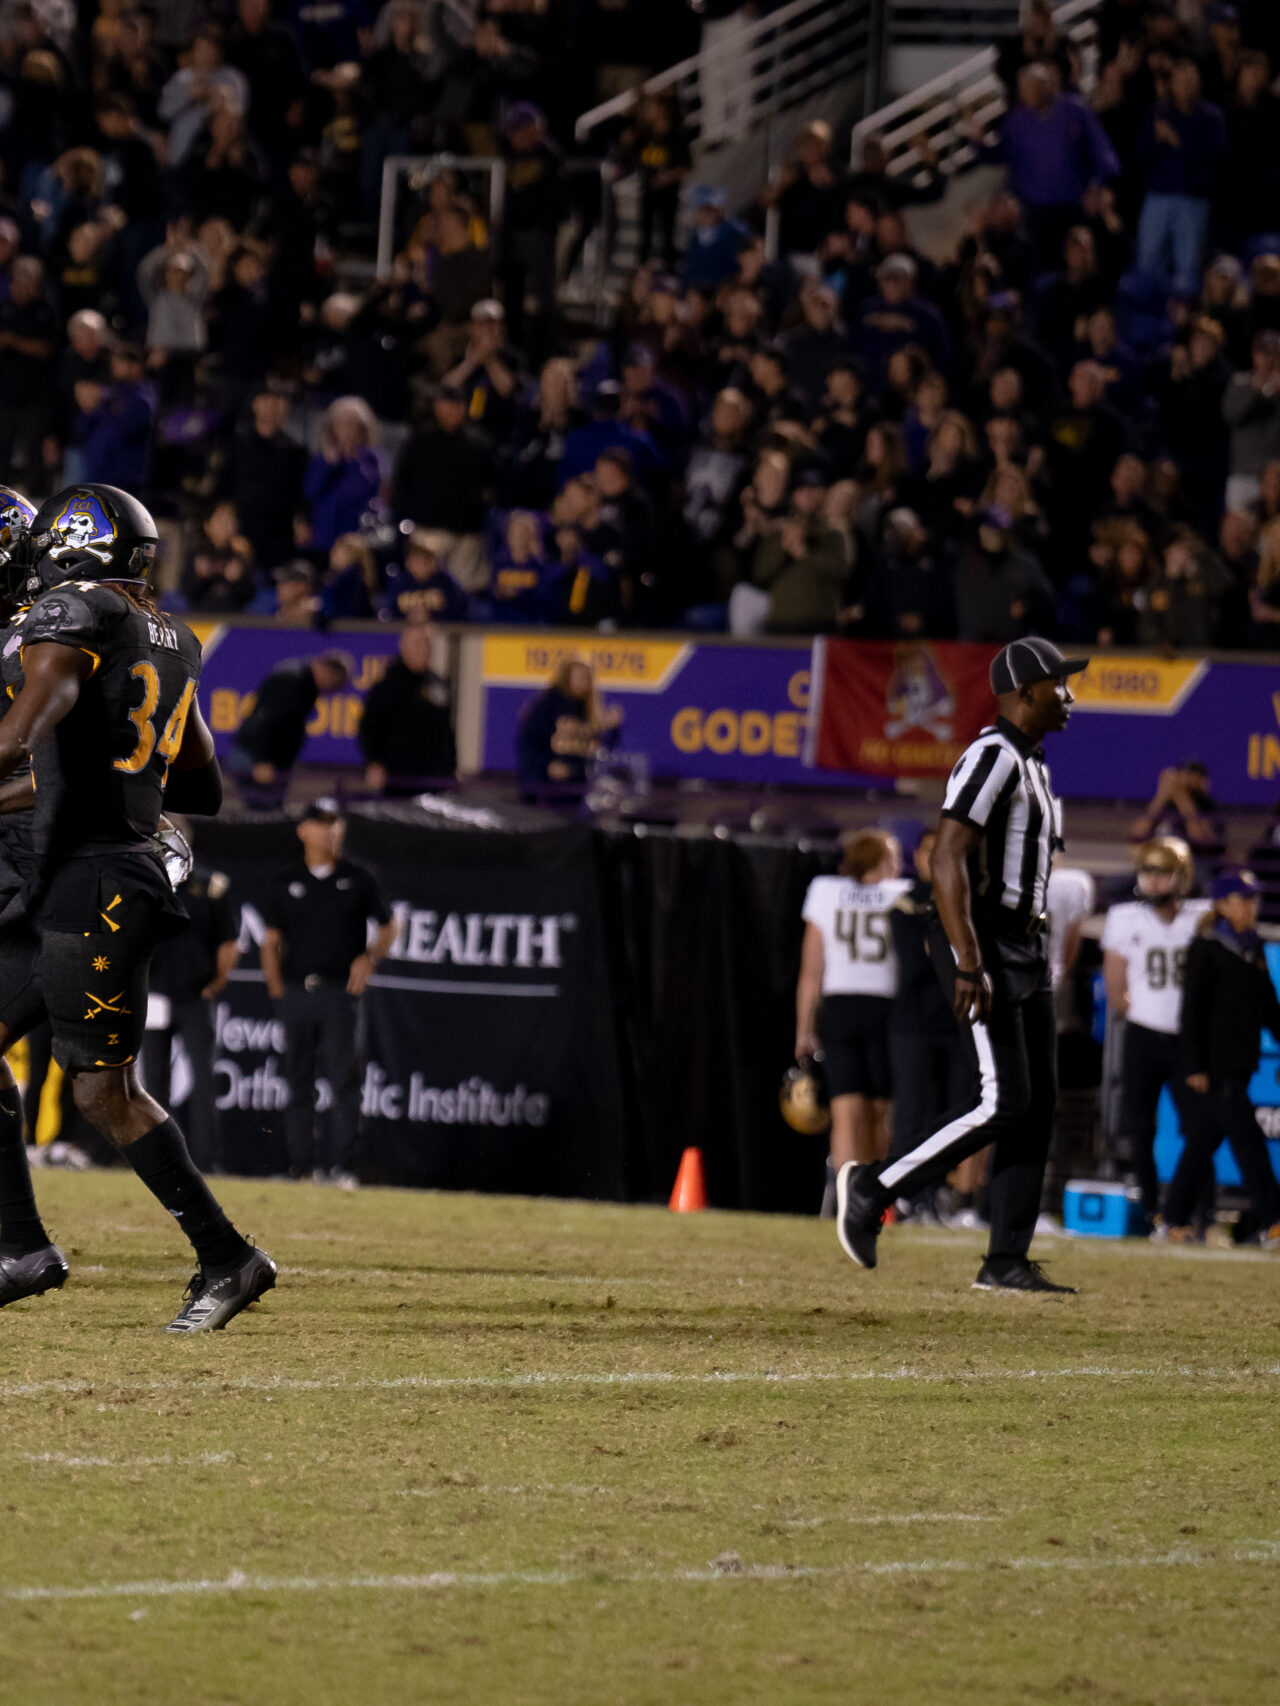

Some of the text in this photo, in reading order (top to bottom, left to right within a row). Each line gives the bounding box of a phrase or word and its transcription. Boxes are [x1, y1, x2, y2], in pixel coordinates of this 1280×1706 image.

[72, 501, 95, 511] ECU
[111, 660, 200, 793] 34
[671, 706, 811, 758] GODE
[834, 908, 889, 963] 45
[408, 1071, 550, 1127] Institute
